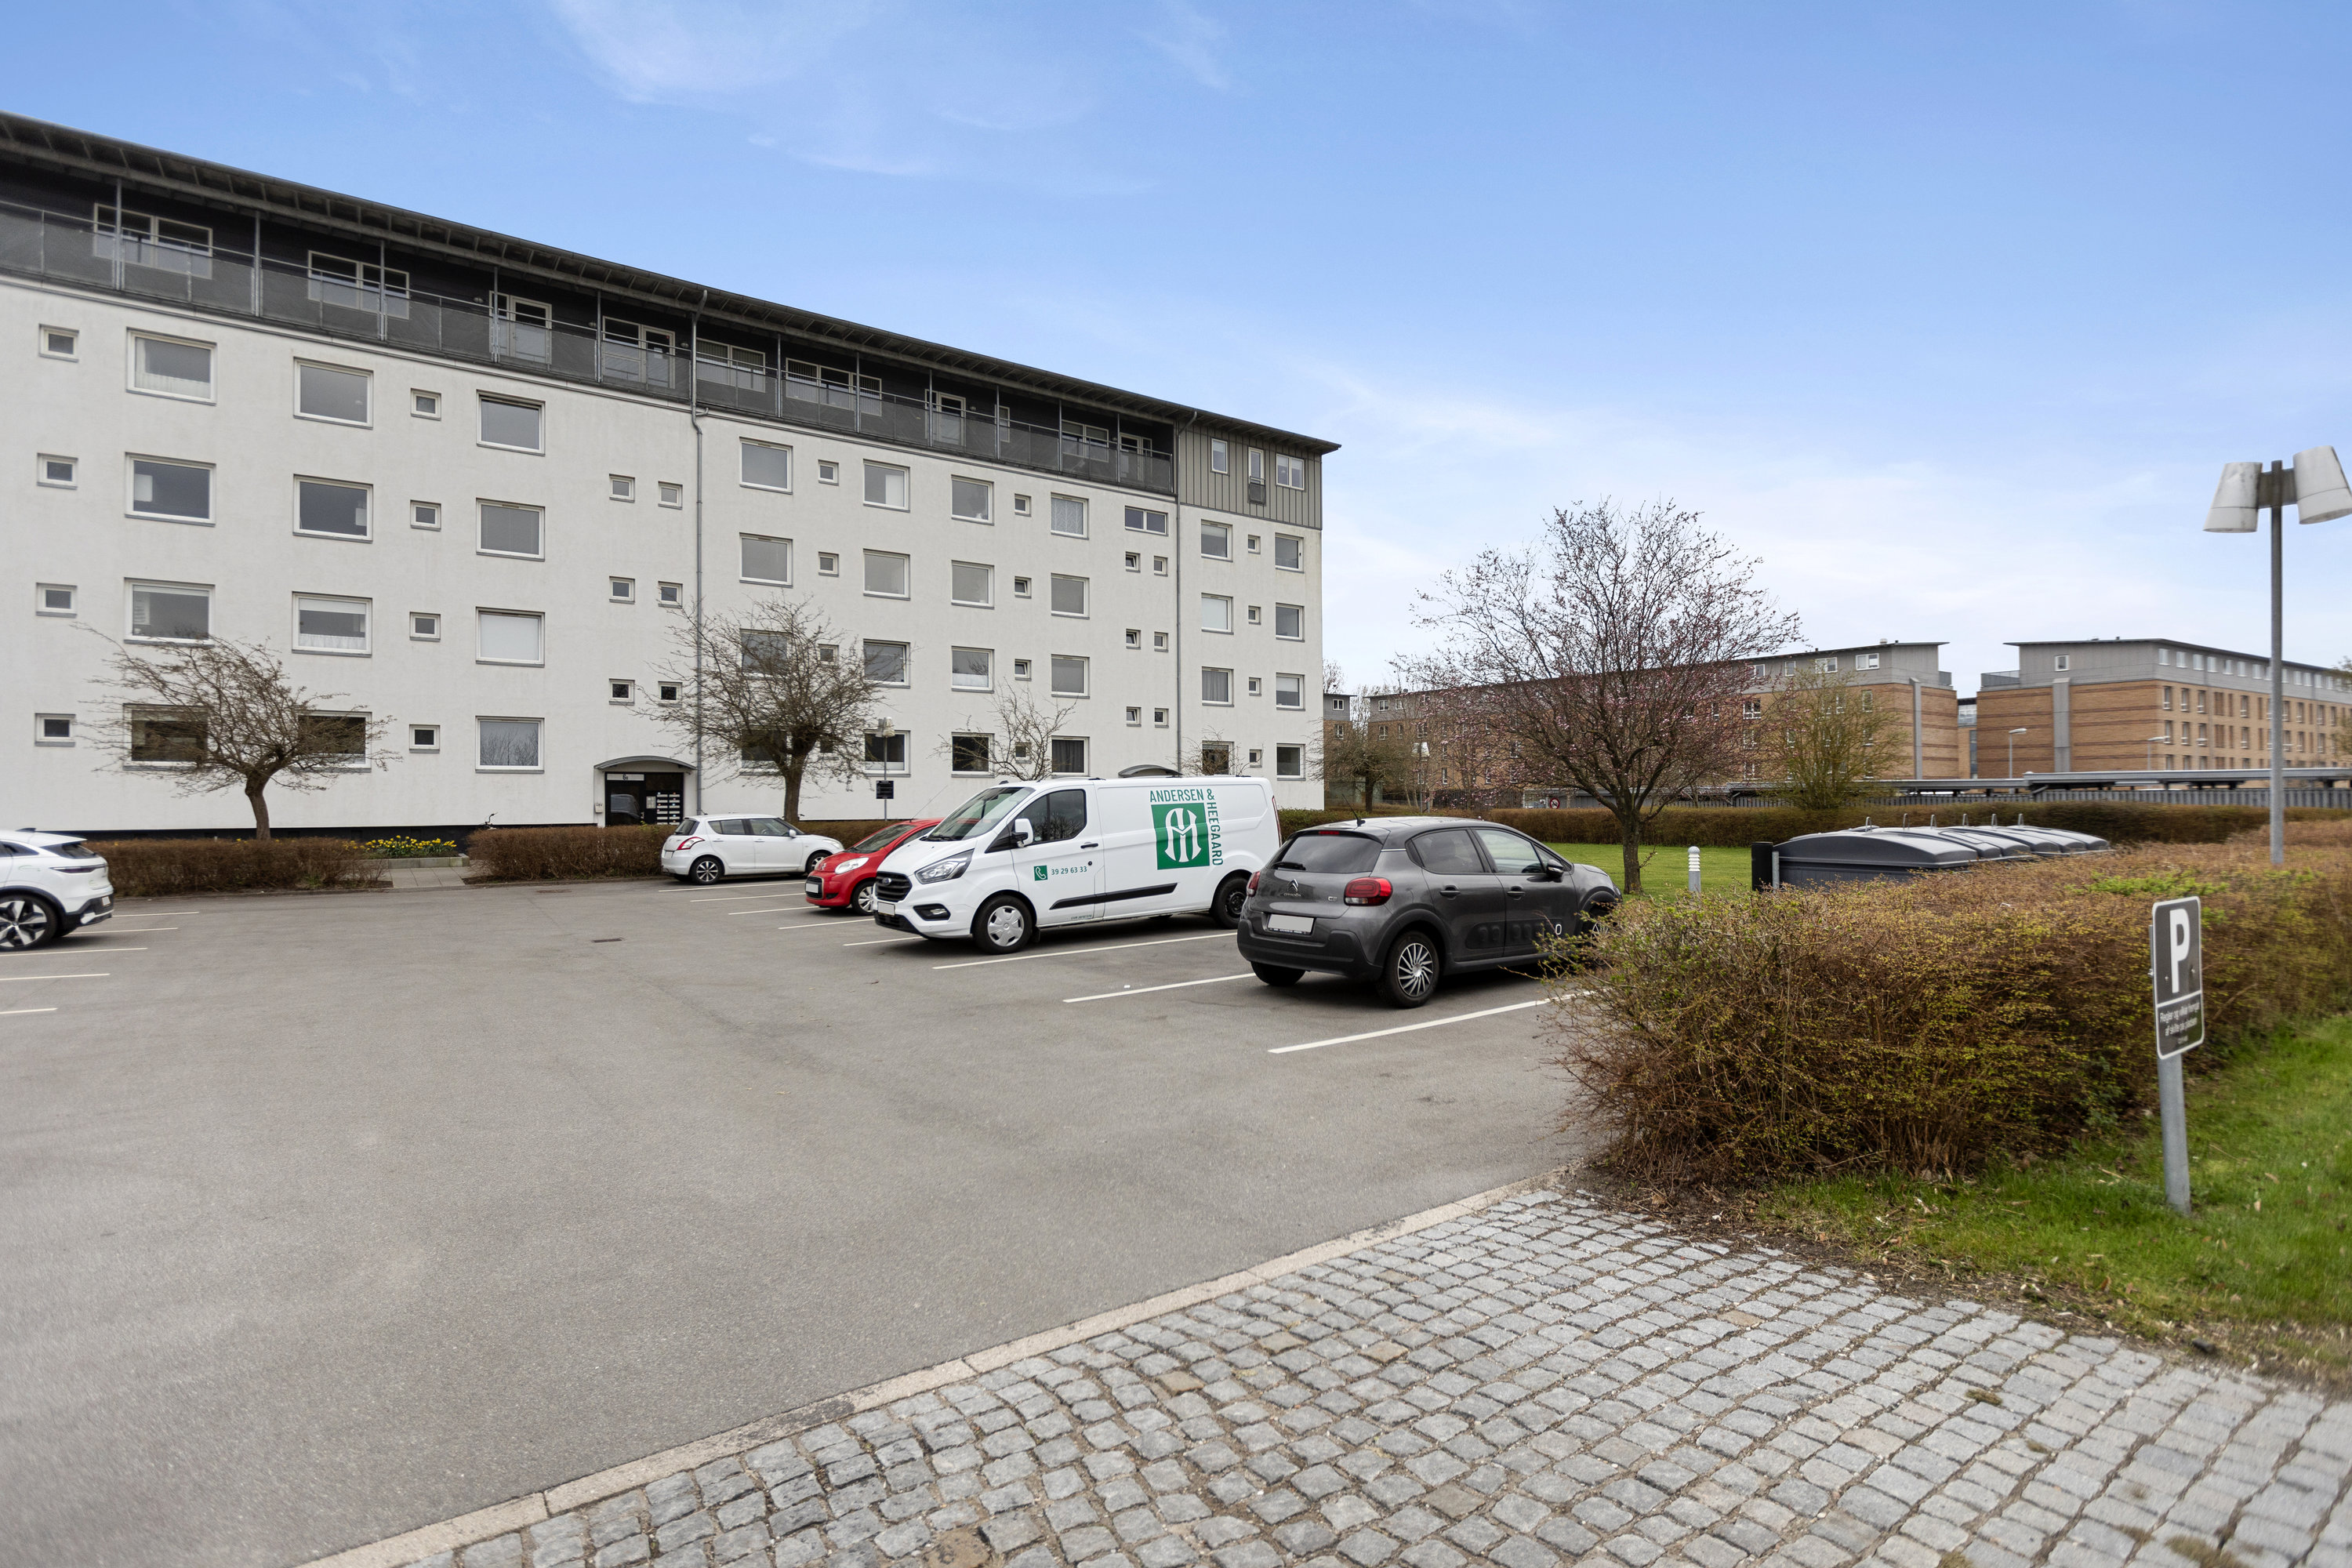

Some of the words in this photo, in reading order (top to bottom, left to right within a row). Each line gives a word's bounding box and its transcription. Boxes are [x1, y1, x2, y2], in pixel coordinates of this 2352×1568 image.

[1149, 789, 1204, 803] ANDERSEN
[1207, 789, 1215, 800] &
[1207, 802, 1224, 866] HEEGAARD
[2169, 909, 2190, 994] P
